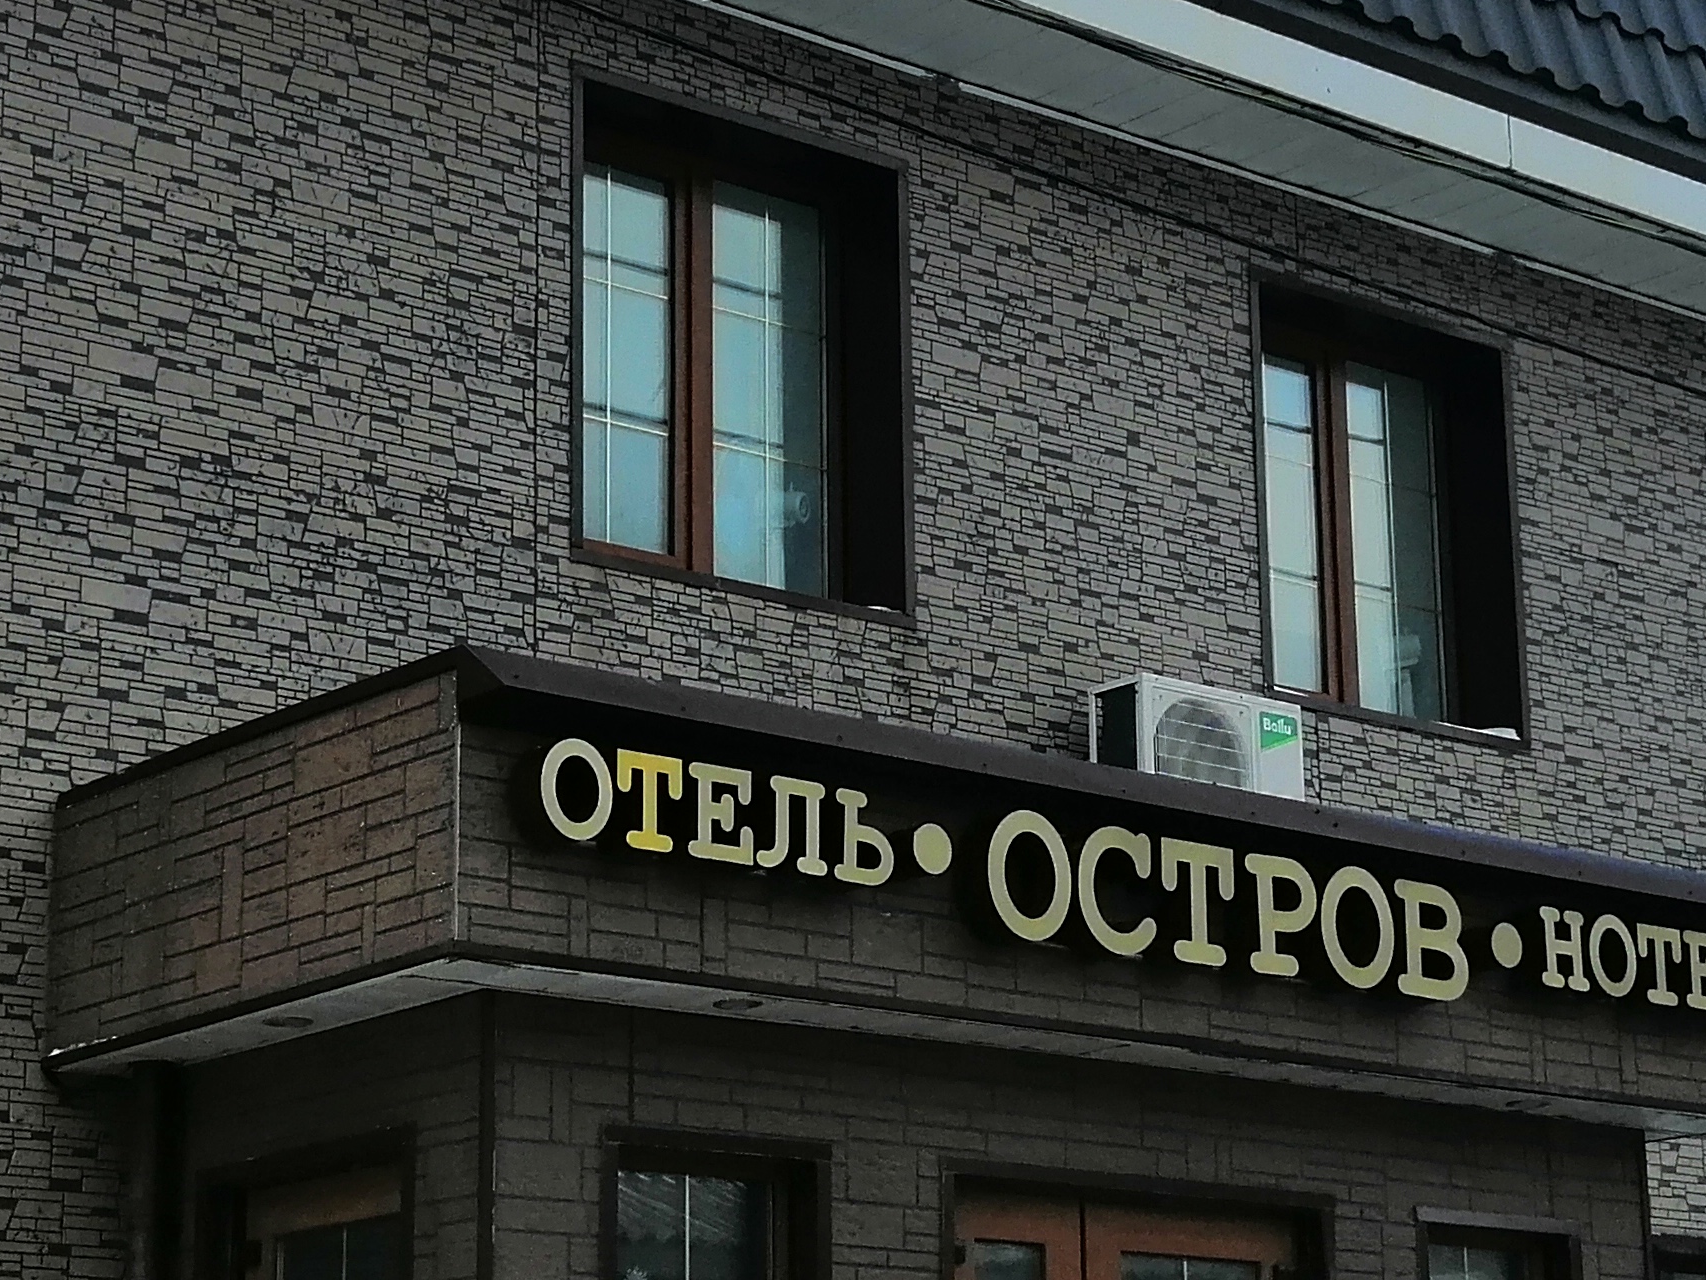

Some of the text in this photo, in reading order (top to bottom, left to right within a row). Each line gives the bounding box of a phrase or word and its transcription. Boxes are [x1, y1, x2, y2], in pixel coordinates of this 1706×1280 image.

[1262, 717, 1291, 736] Ballu
[540, 737, 895, 887] ОТЕЛЬ
[987, 809, 1470, 1001] ОСТРОВ
